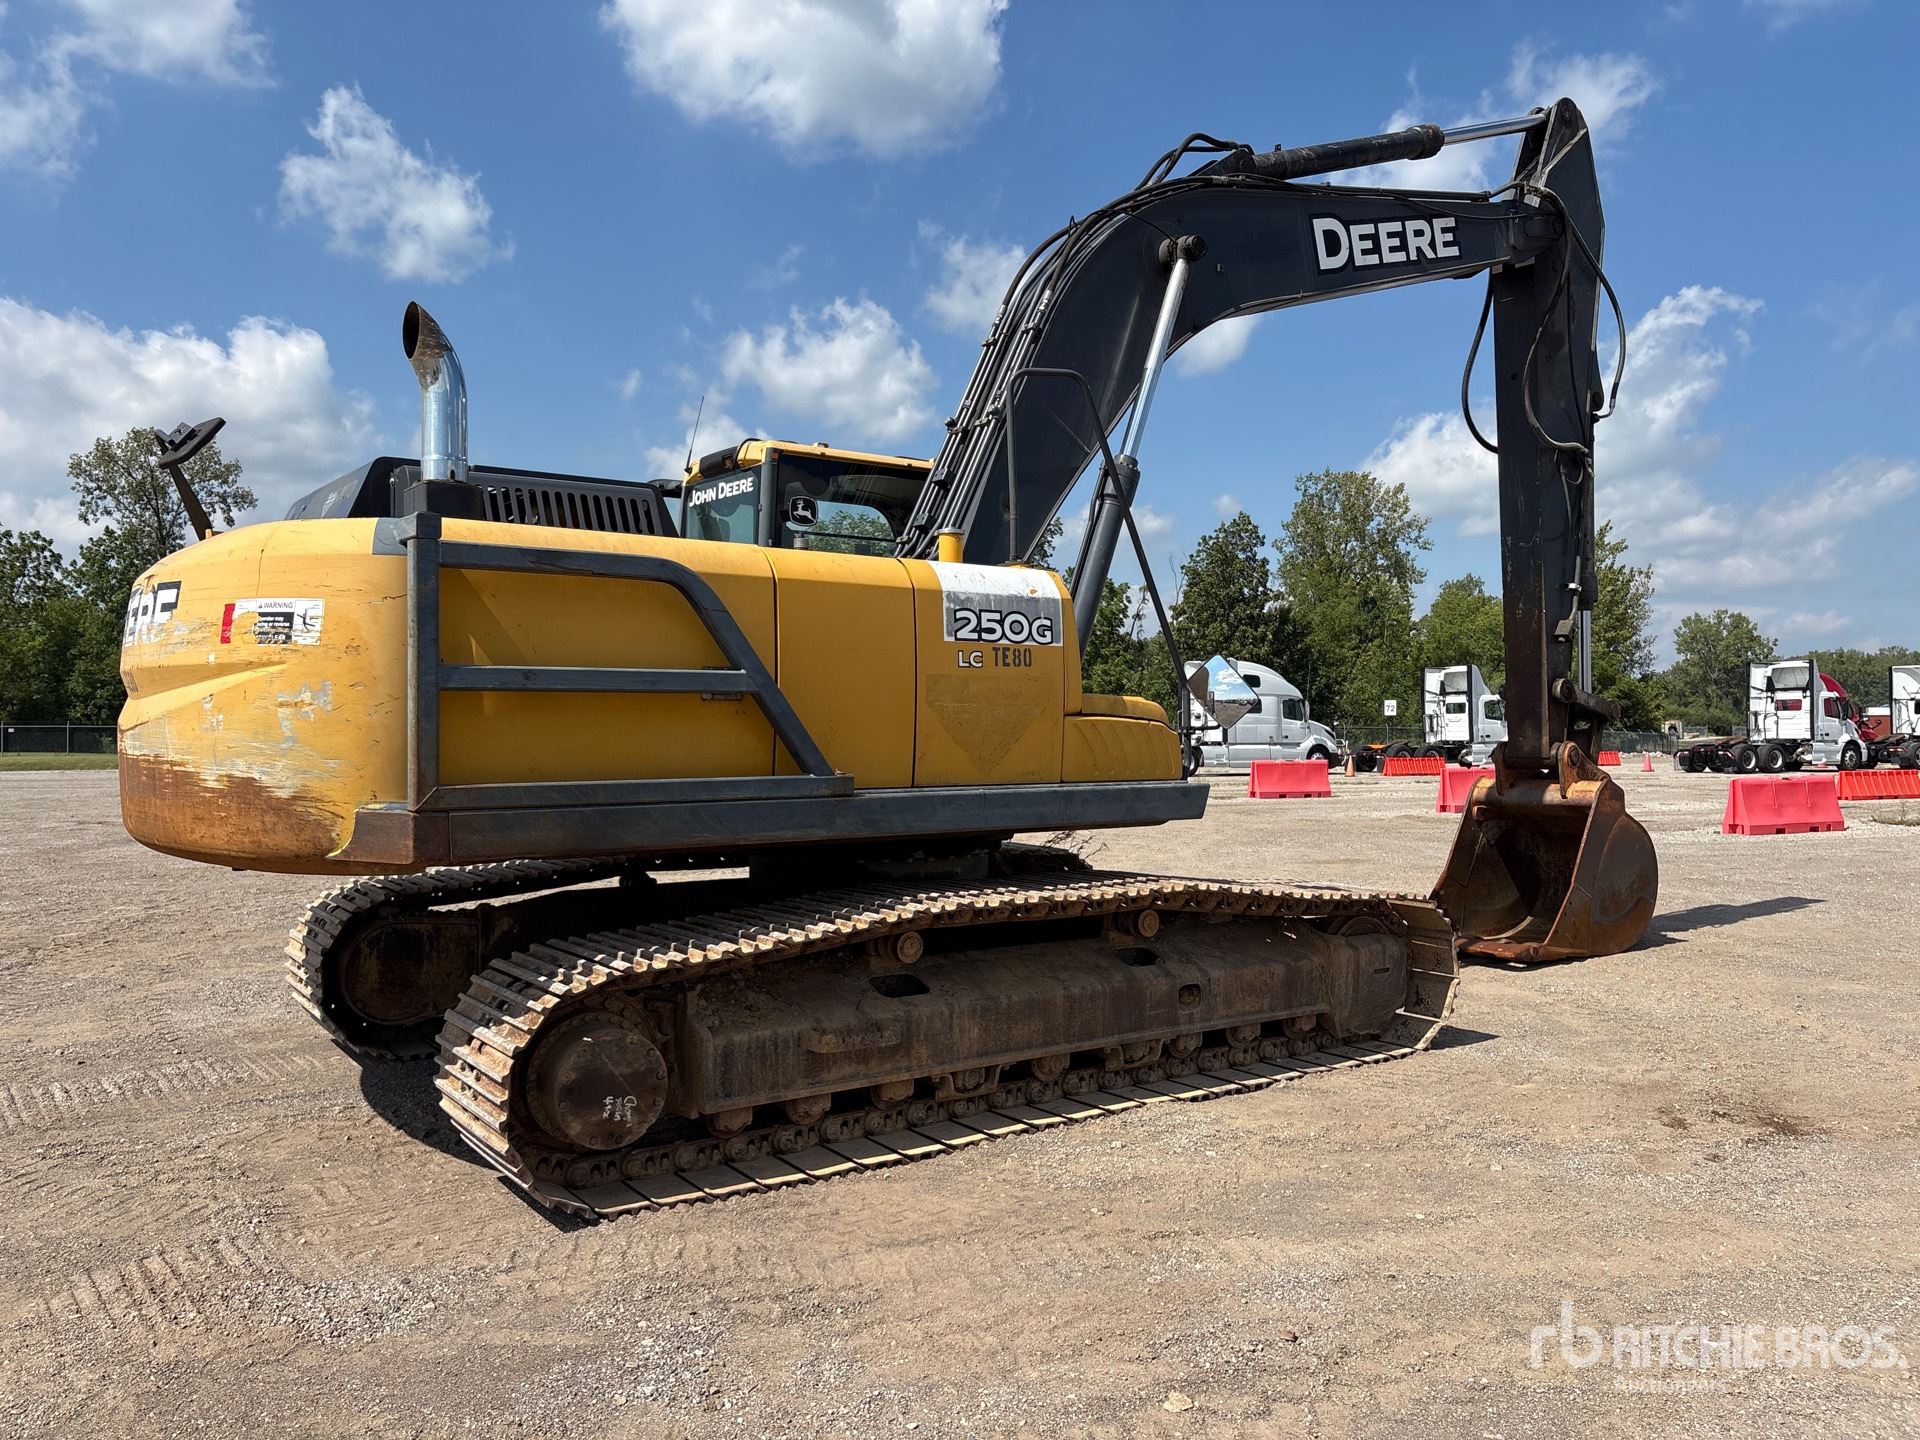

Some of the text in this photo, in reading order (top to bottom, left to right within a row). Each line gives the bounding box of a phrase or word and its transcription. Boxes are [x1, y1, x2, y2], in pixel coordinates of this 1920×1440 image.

[1312, 217, 1460, 270] DEERE
[689, 477, 755, 507] JOHN DEERE
[954, 608, 1053, 645] 250G
[958, 650, 983, 668] LC
[992, 647, 1032, 667] TE80
[1386, 704, 1395, 712] 72
